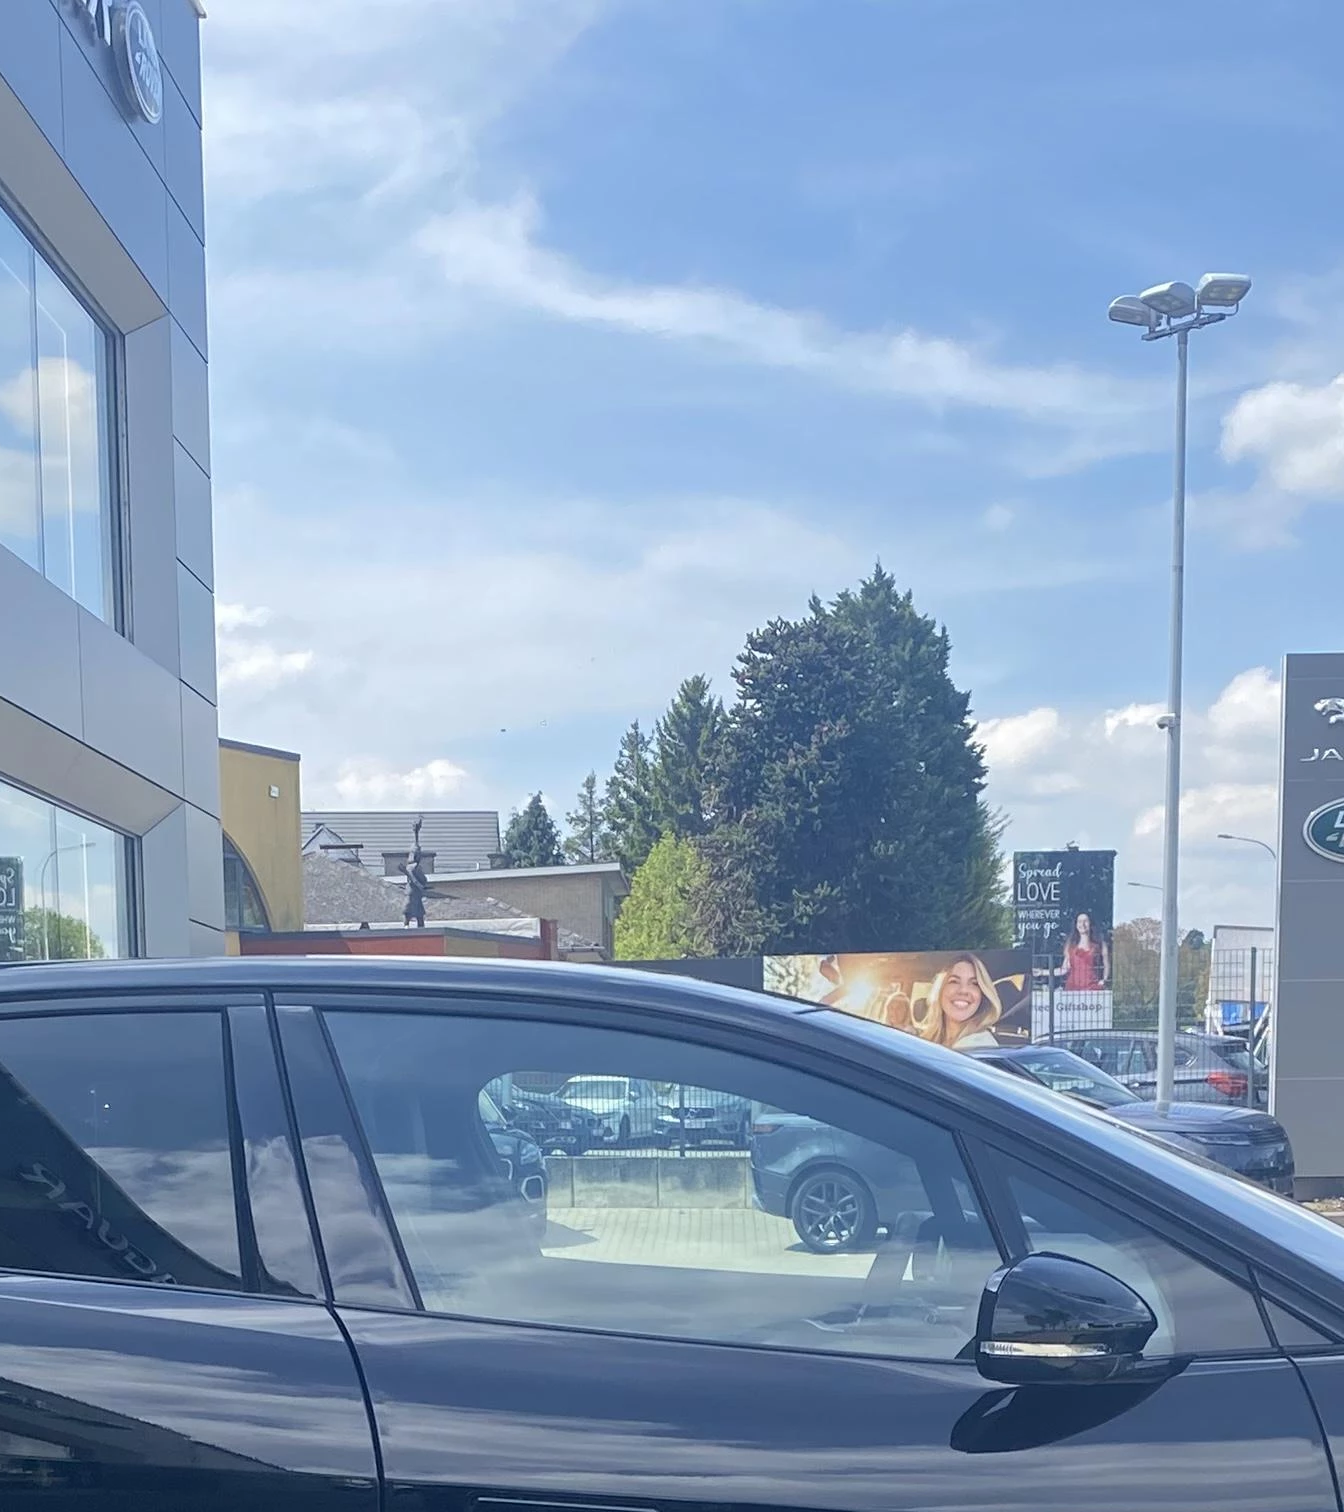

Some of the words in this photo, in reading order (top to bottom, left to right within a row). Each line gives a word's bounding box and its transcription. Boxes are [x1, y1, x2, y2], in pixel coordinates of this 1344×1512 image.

[1018, 862, 1063, 885] Spread
[1017, 882, 1061, 902] LOVE
[1017, 909, 1061, 919] WHEREVER
[1017, 922, 1042, 940] you
[1043, 922, 1060, 939] go
